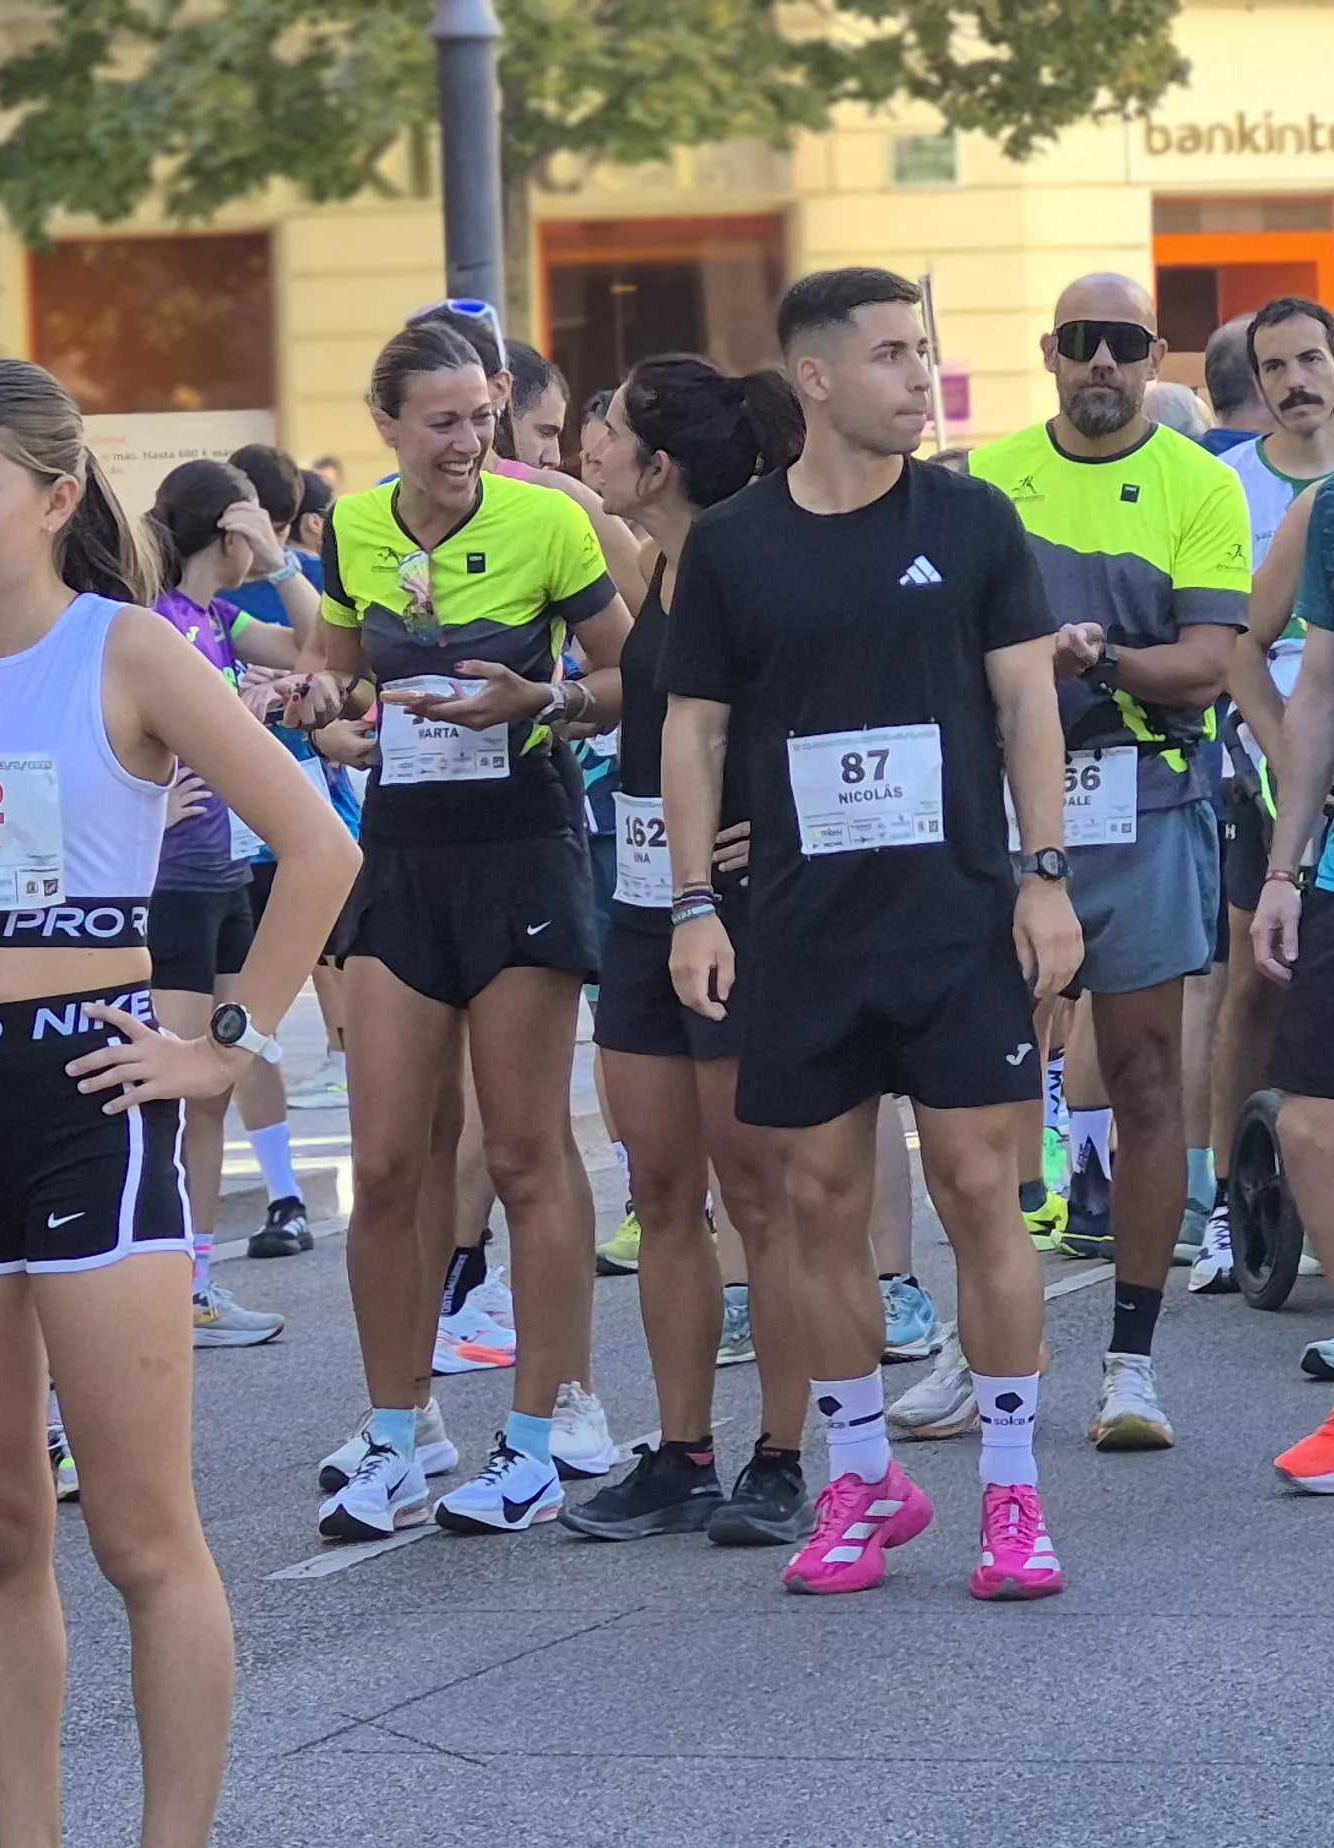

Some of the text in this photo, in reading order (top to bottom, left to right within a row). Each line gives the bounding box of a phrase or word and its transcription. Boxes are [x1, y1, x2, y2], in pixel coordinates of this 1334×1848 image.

[840, 748, 890, 784] 87
[838, 783, 904, 805] NICOLÁS
[625, 814, 668, 848] 162
[2, 907, 125, 938] PRO
[31, 989, 152, 1041] NIKE
